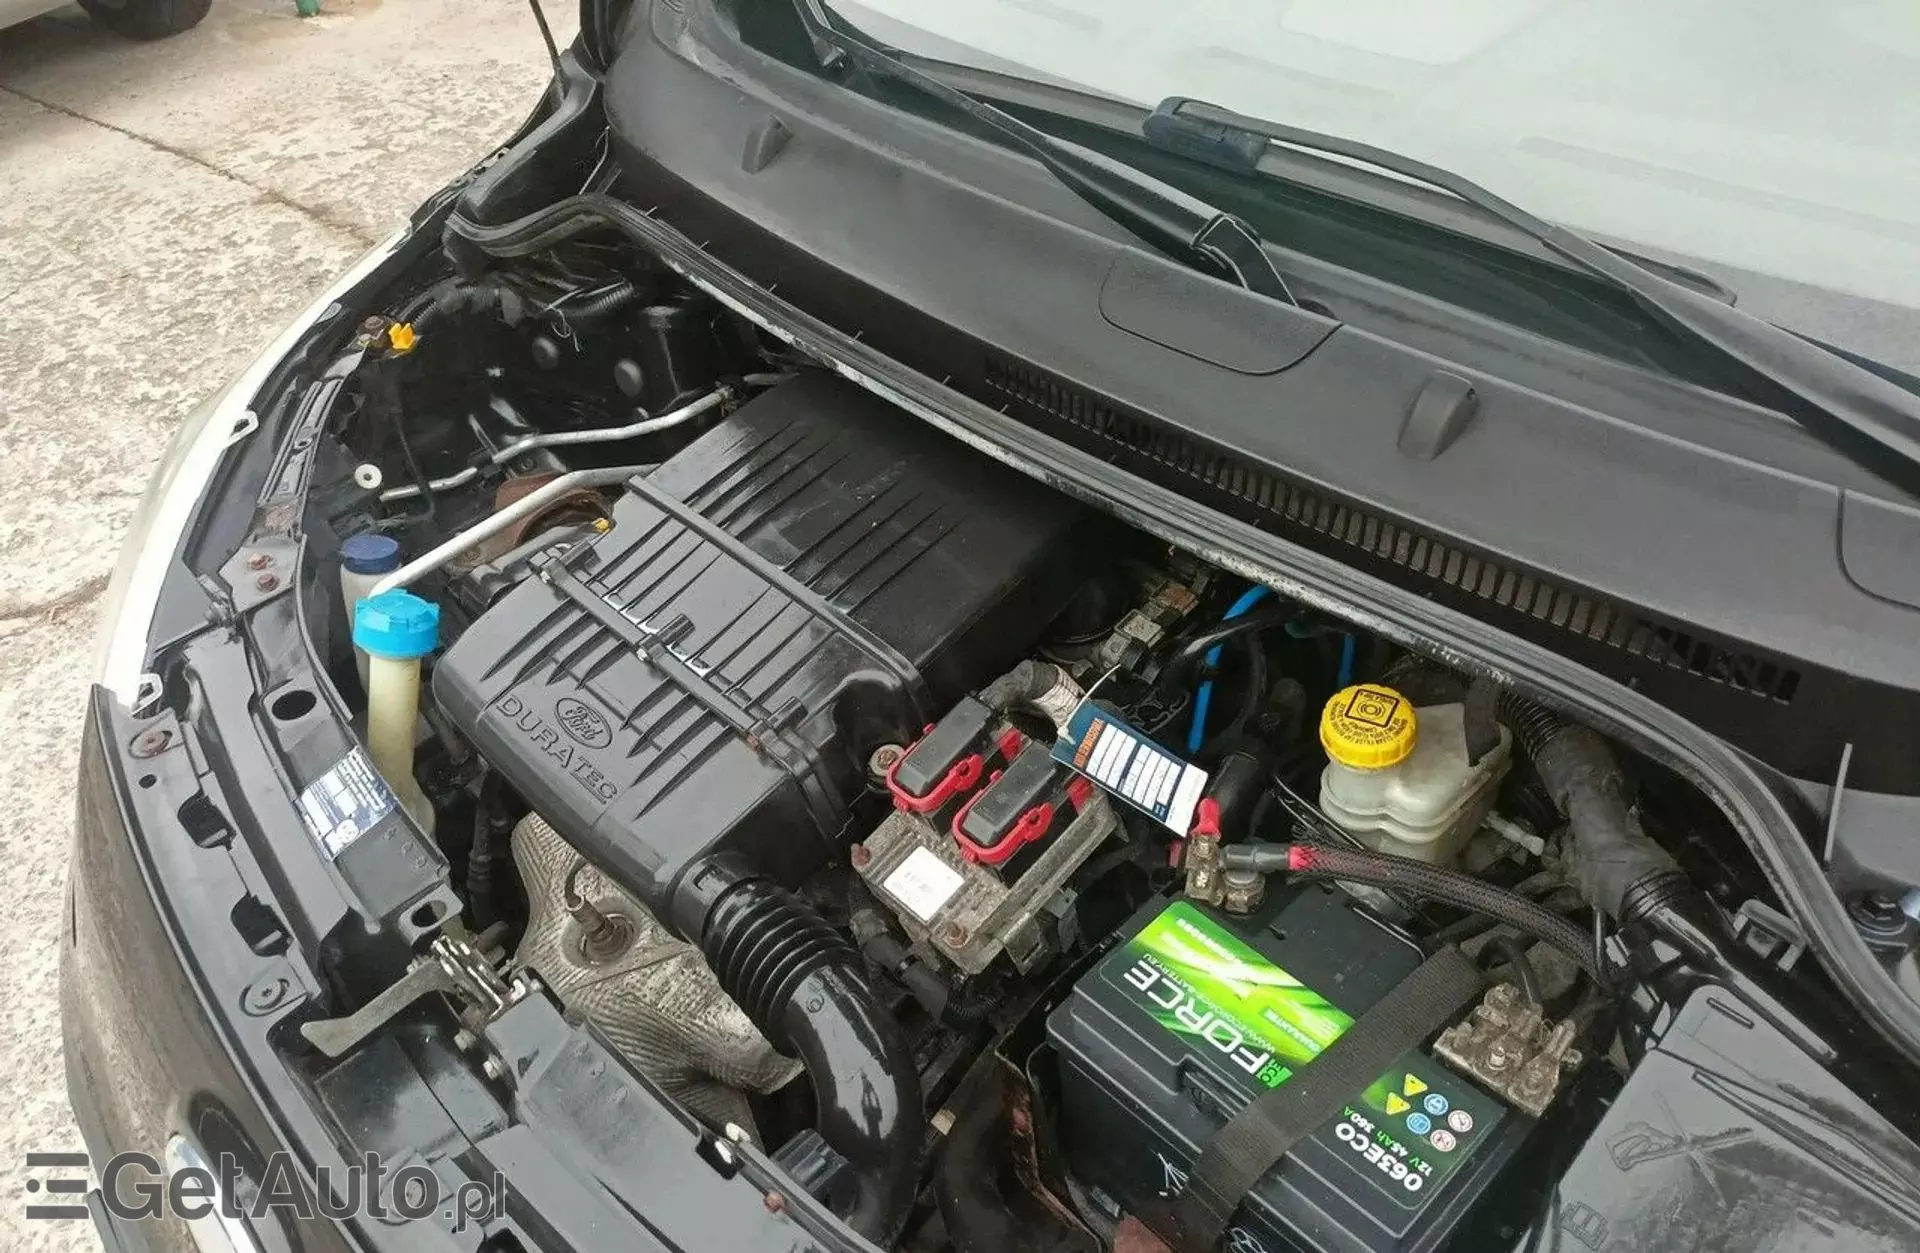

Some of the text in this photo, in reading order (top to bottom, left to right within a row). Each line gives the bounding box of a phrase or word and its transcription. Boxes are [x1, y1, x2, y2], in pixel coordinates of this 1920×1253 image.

[562, 706, 604, 741] Ford
[496, 693, 618, 801] DURATEC
[1123, 960, 1270, 1075] FORCE
[1261, 1059, 1284, 1083] ECO
[1335, 1122, 1423, 1191] 063ECO
[1377, 1130, 1408, 1157] 45Ah
[1409, 1156, 1433, 1177] 12V
